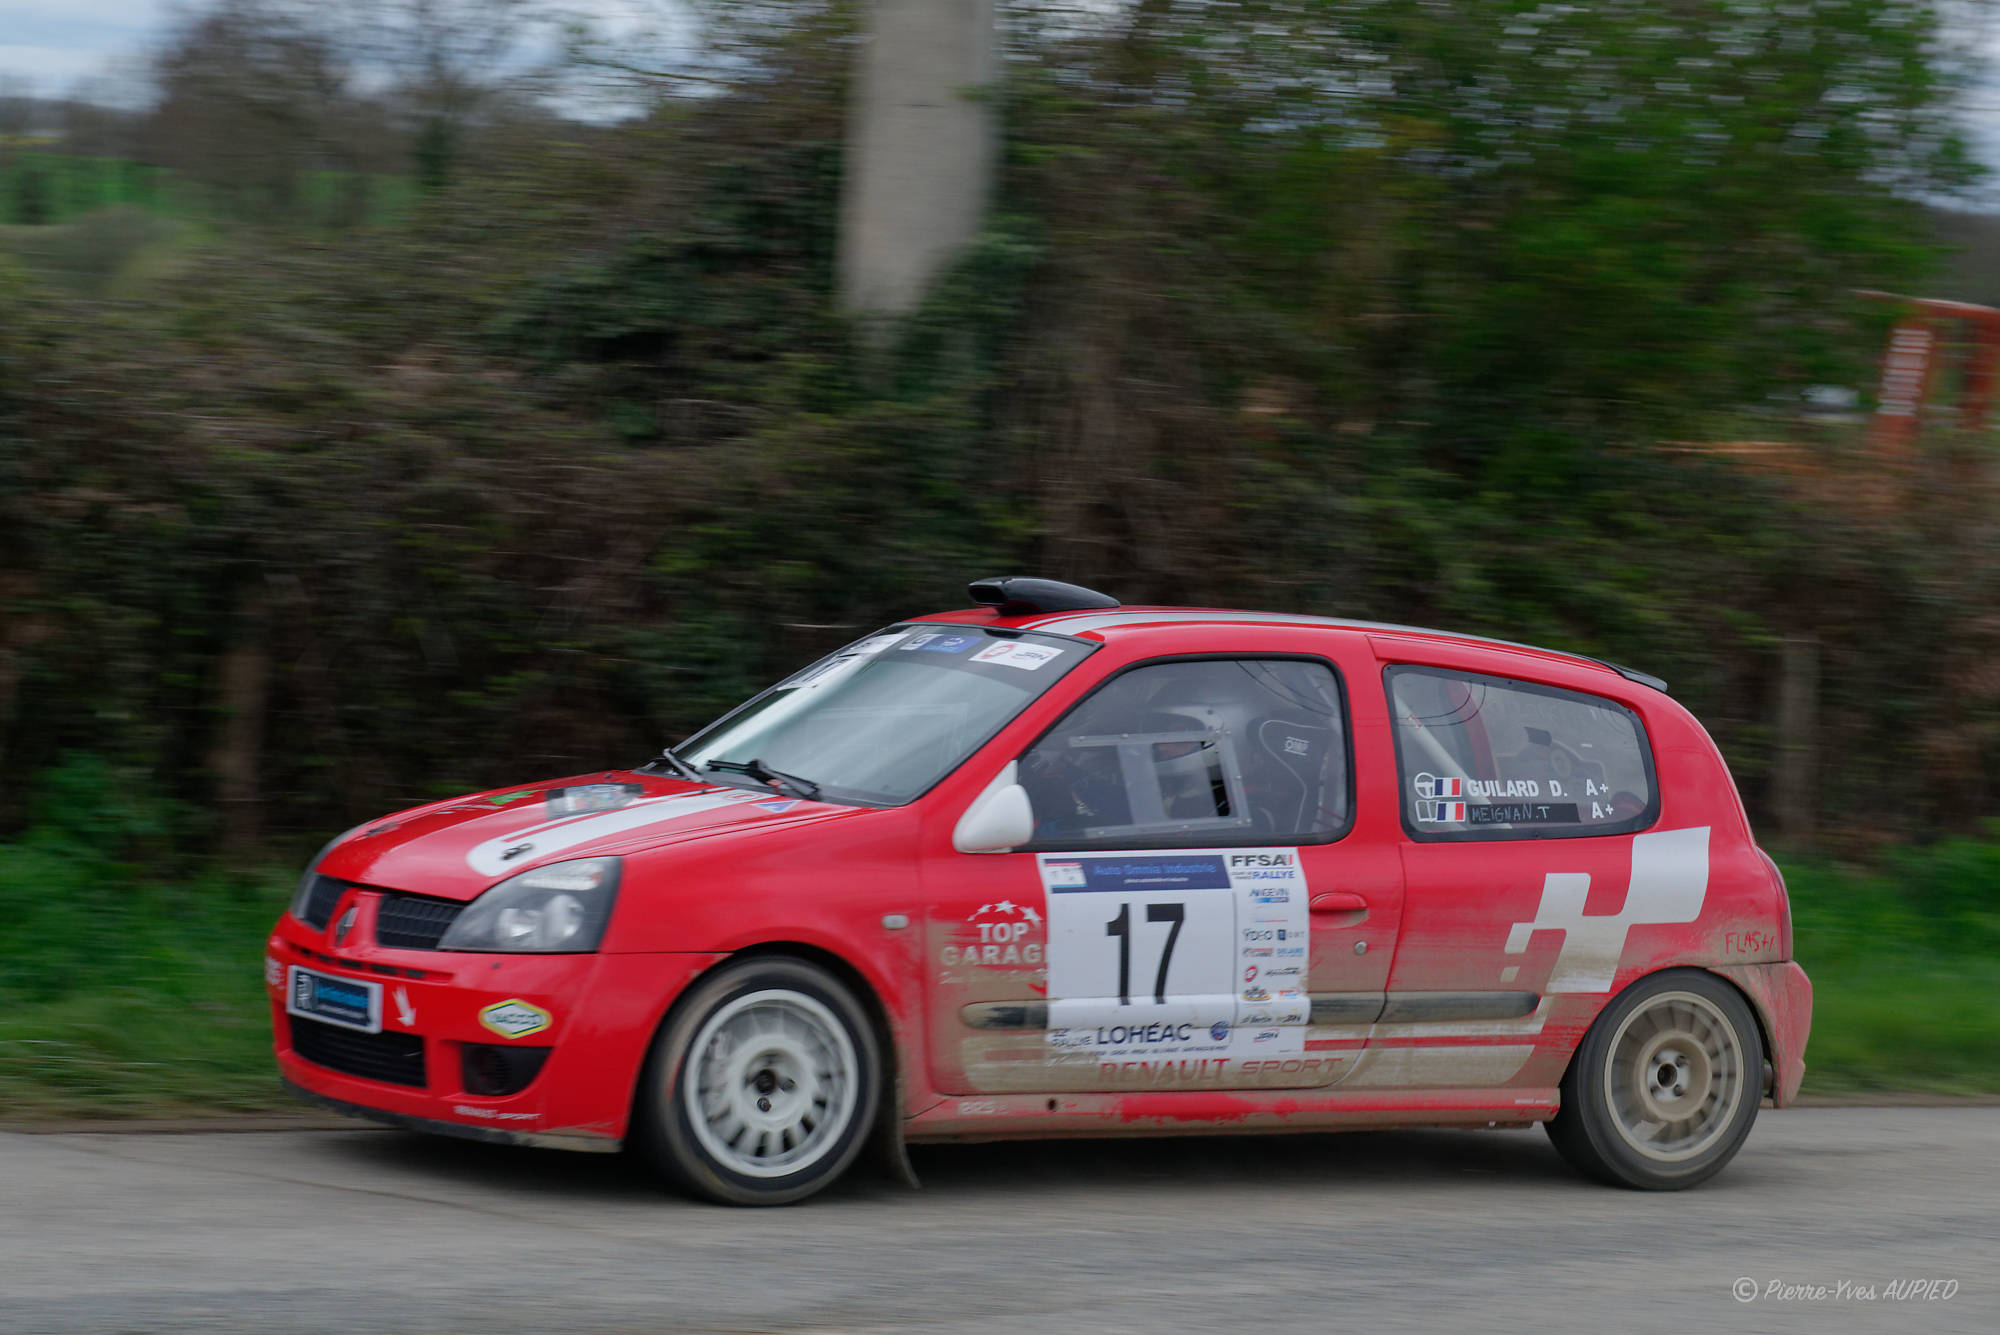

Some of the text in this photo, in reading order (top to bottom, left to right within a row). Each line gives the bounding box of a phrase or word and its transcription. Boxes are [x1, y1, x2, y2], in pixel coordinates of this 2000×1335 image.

[1467, 778, 1609, 798] GUILARD D. A+
[1592, 801, 1614, 819] A+
[1231, 854, 1287, 867] FFSA
[976, 922, 1029, 943] TOP
[941, 943, 1047, 966] GARAG
[1106, 902, 1185, 1006] 17
[1097, 1021, 1193, 1045] LOHÉAC
[1101, 1057, 1345, 1082] RENAULT SPORT
